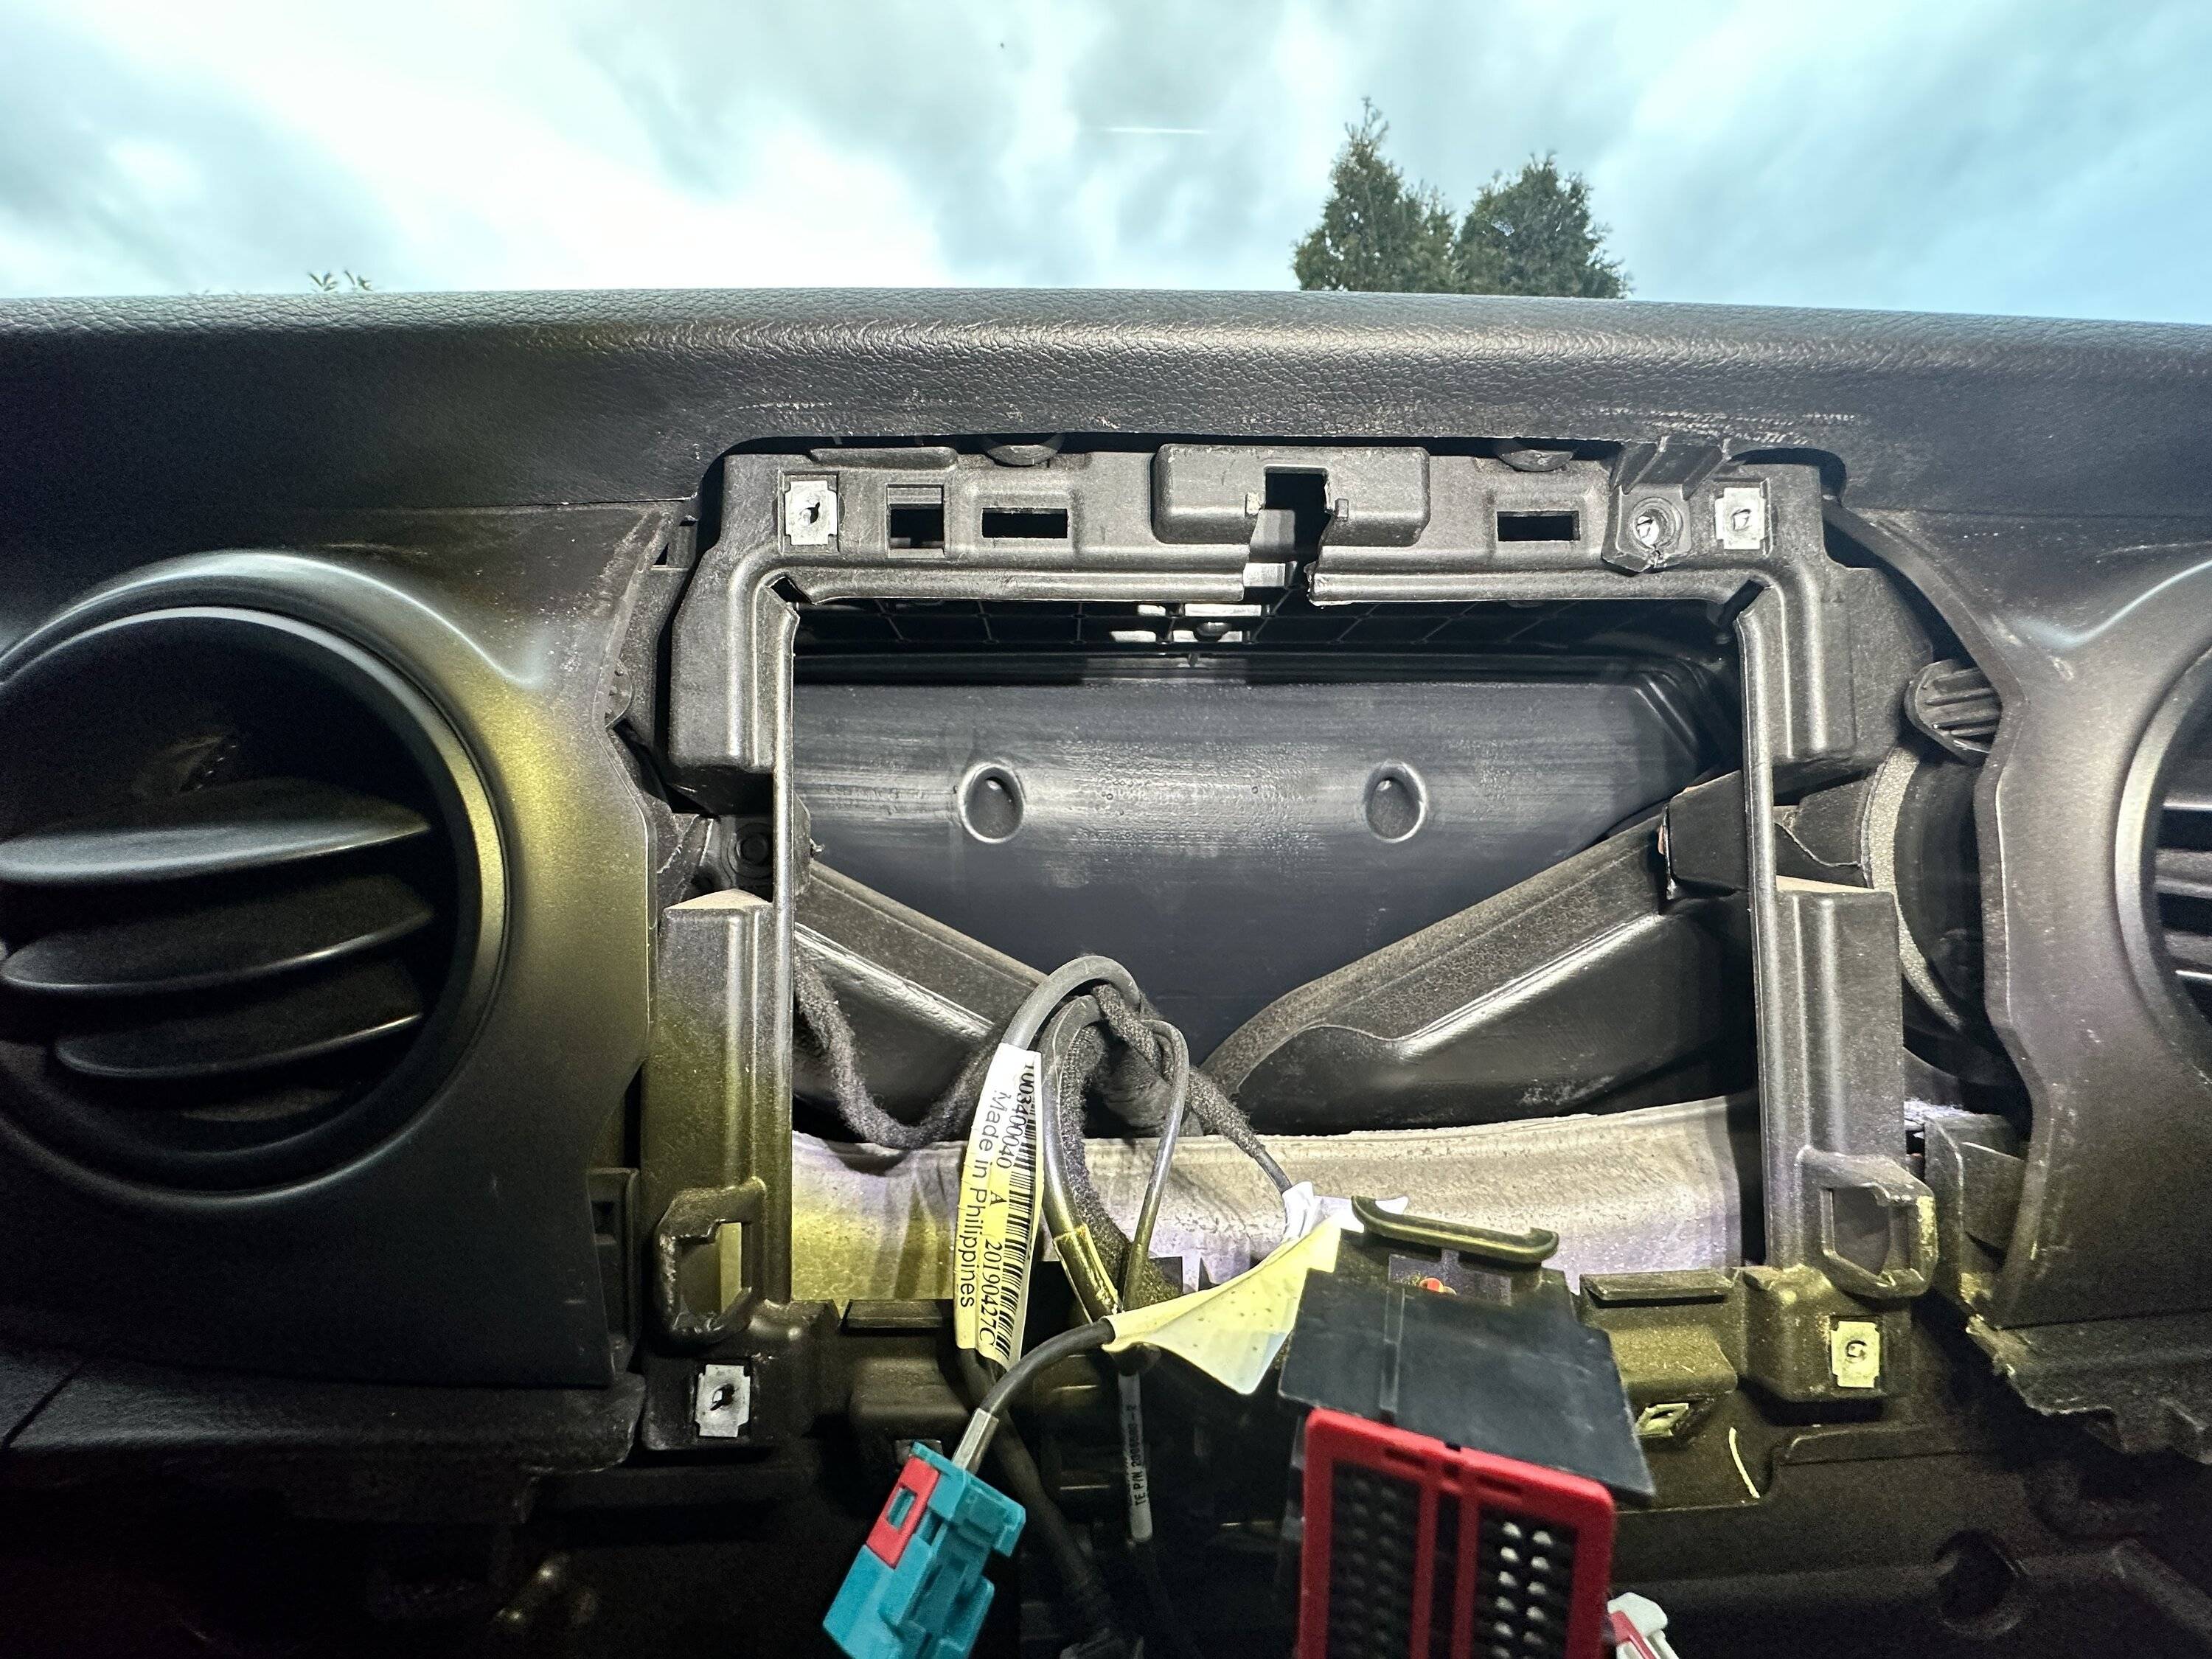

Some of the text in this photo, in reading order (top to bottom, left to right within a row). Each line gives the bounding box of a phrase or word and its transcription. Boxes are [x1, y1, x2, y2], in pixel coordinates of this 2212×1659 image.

[958, 1090, 1012, 1308] Made in Philippines
[990, 1189, 1008, 1207] A
[979, 1238, 1003, 1347] 20190427C
[1132, 1472, 1145, 1490] P/N
[1134, 1492, 1146, 1506] TE
